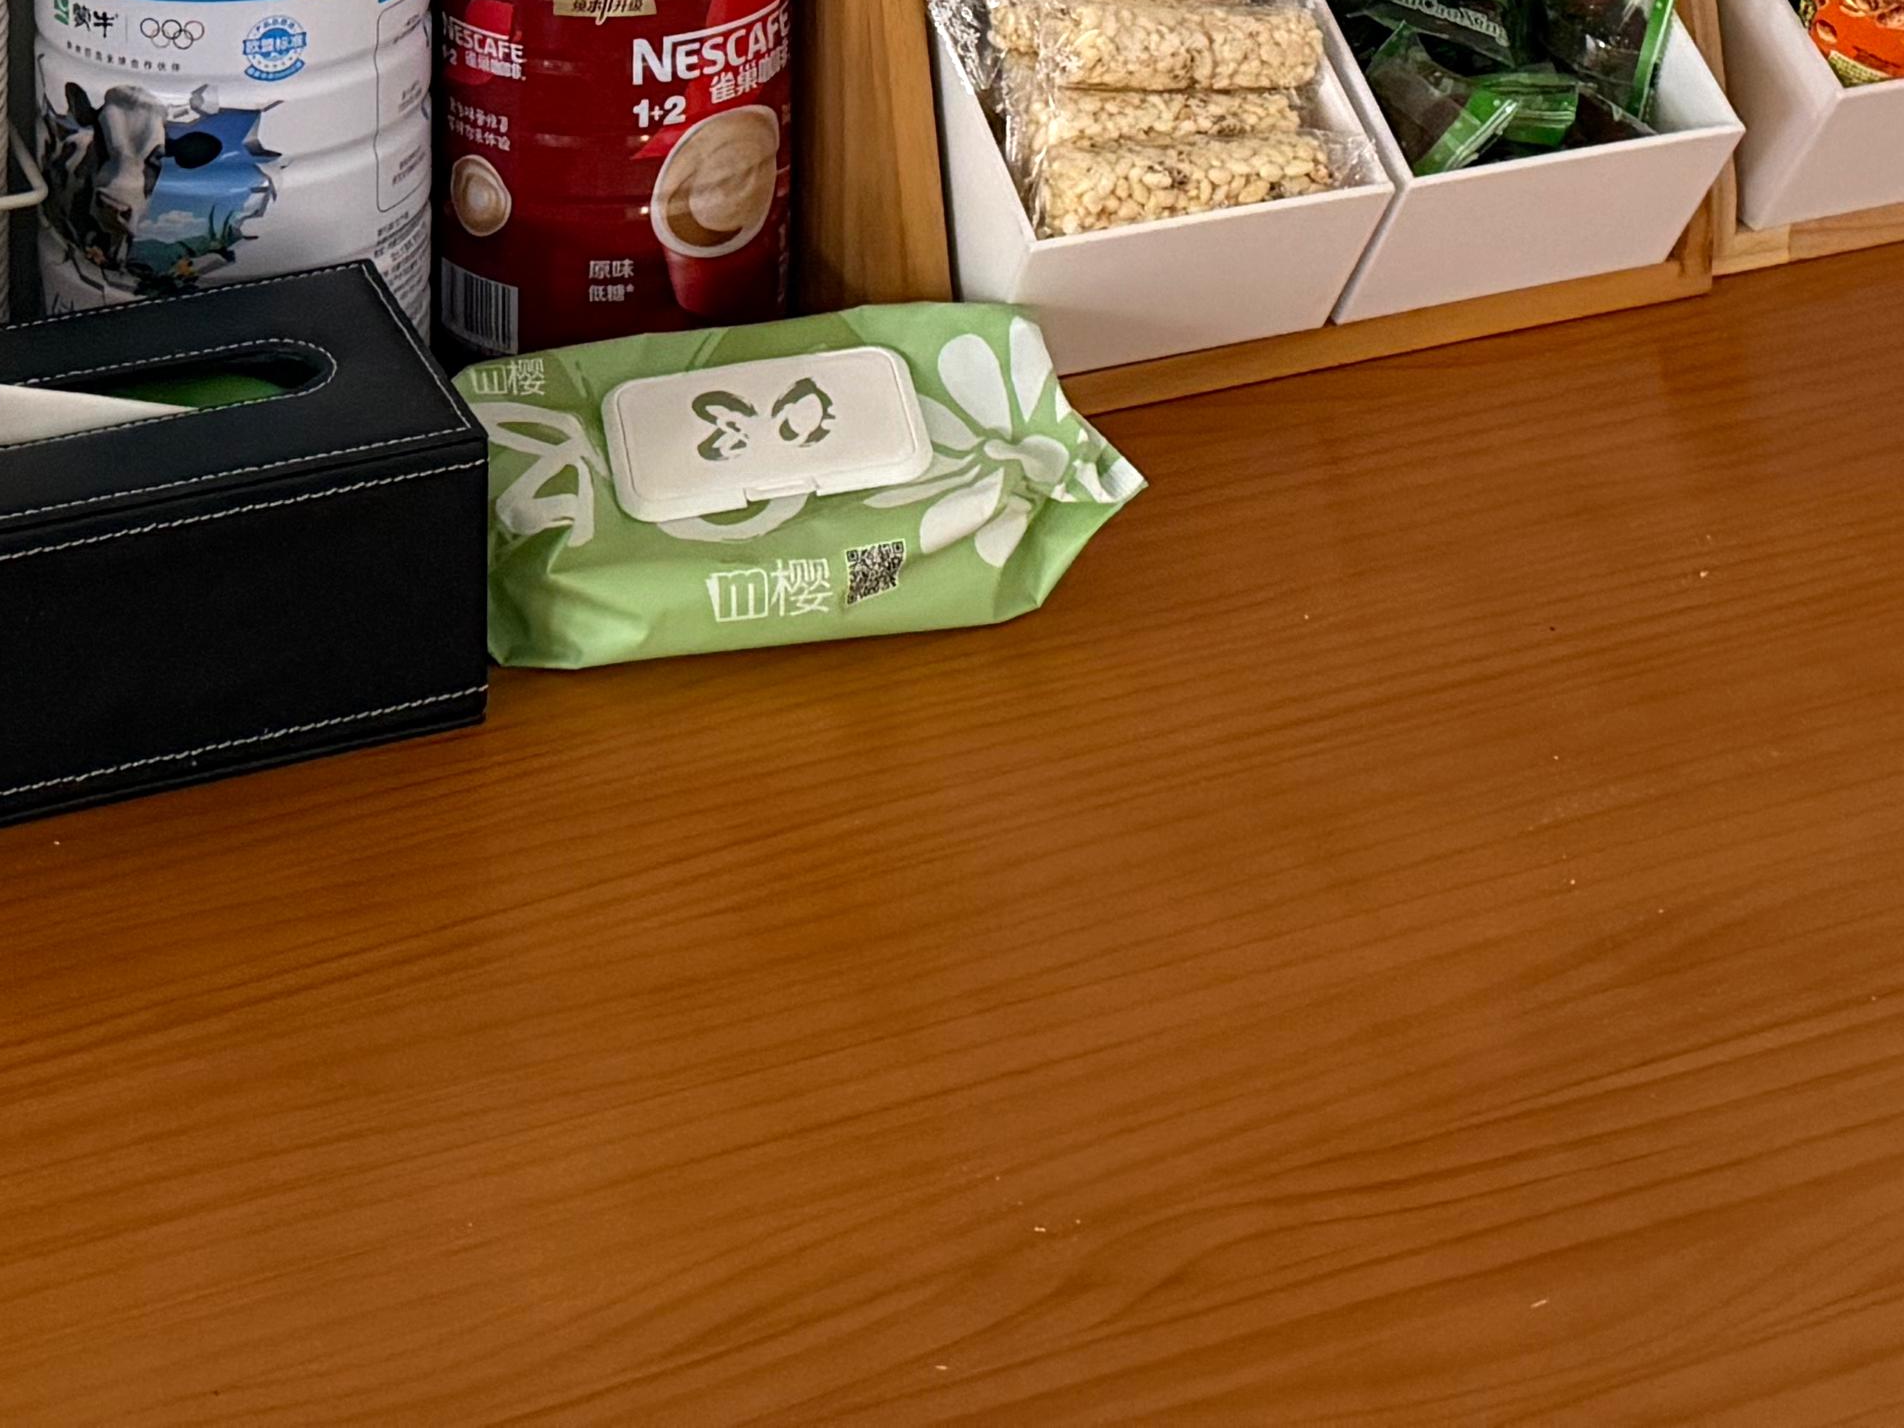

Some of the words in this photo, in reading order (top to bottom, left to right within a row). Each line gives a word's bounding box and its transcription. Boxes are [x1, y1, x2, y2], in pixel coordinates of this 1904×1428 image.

[72, 1, 116, 39] 蒙牛
[633, 95, 687, 128] 1+2
[588, 259, 635, 280] 原味
